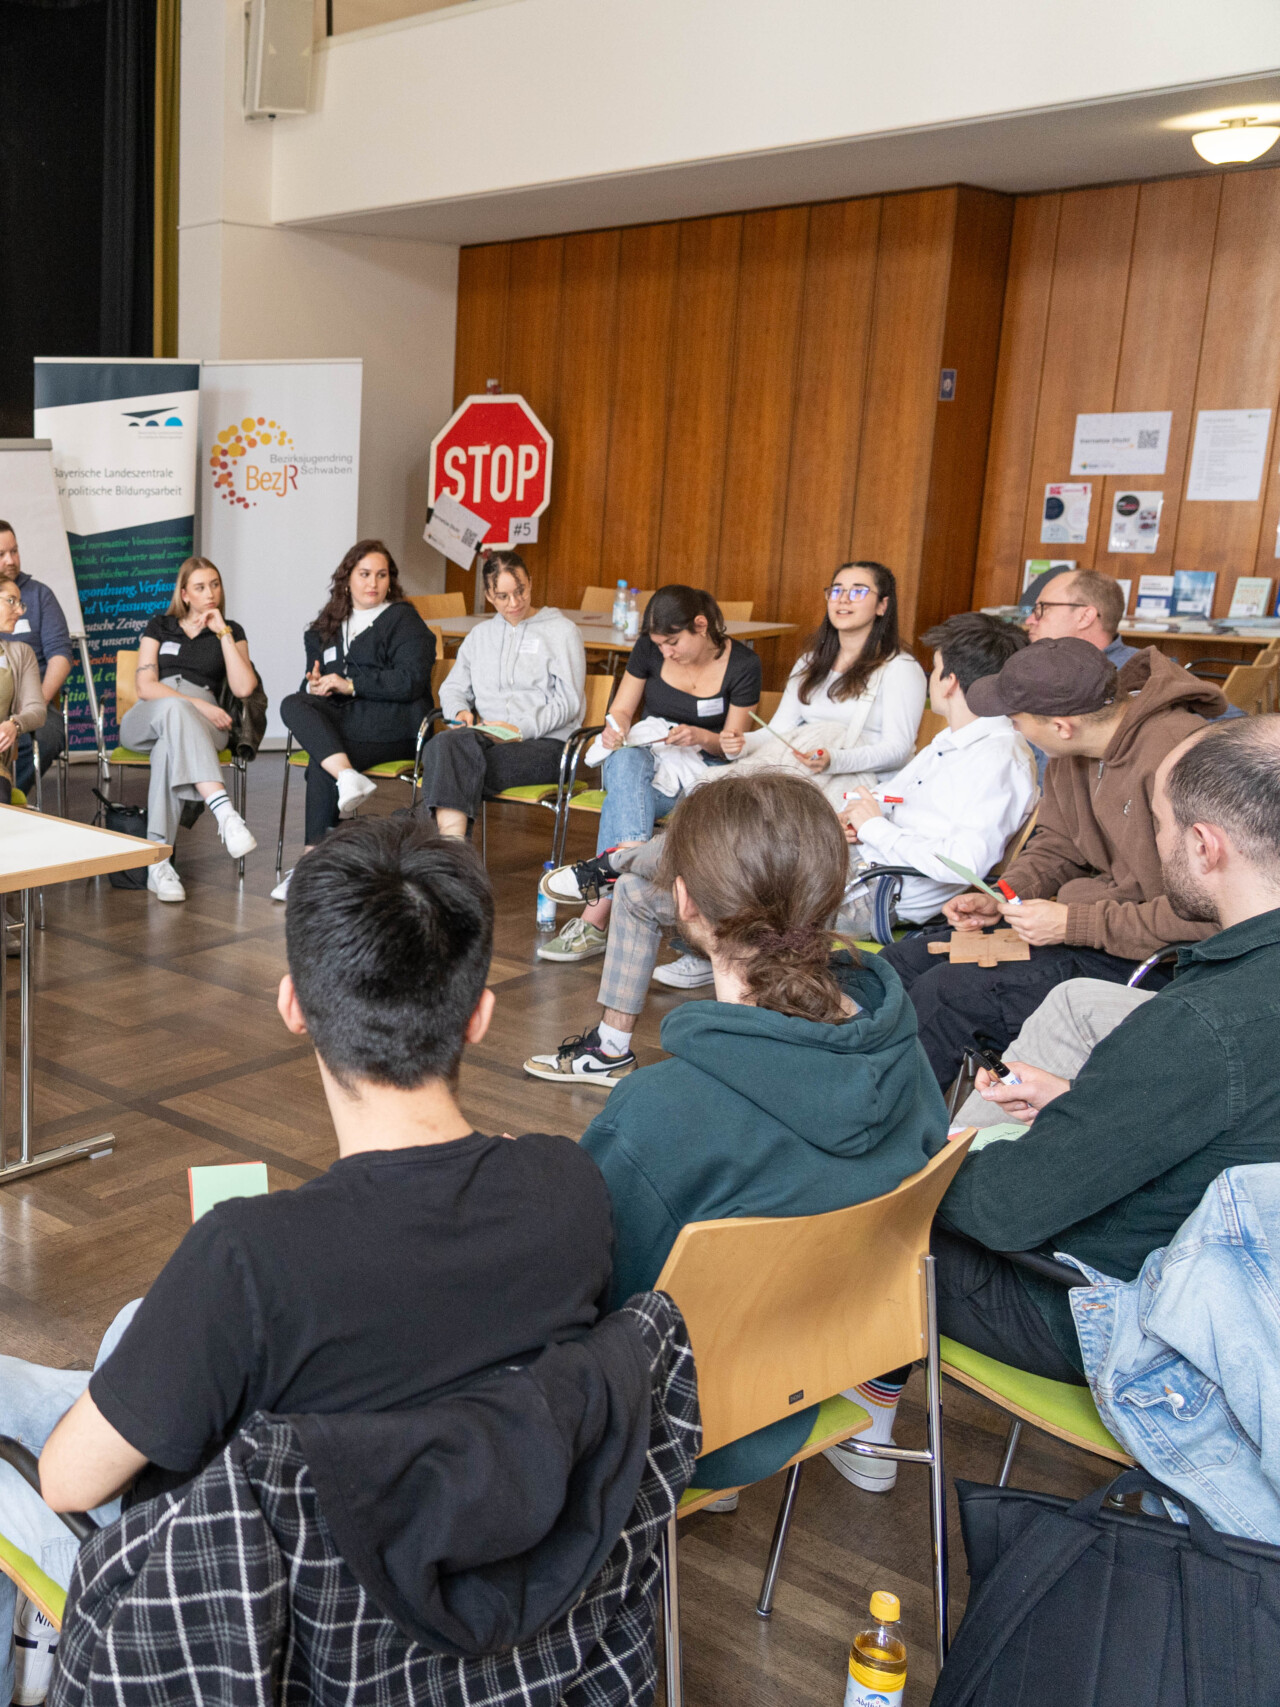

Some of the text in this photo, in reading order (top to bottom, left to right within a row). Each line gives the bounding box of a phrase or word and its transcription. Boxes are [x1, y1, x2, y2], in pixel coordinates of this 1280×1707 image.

[270, 454, 353, 464] Bezirksjugendring
[104, 467, 174, 478] Landeszentrale
[300, 465, 353, 475] Schwaben
[442, 444, 540, 503] STOP
[68, 486, 112, 499] politische
[115, 484, 182, 498] Bildungsarbeit
[513, 522, 531, 536] #5
